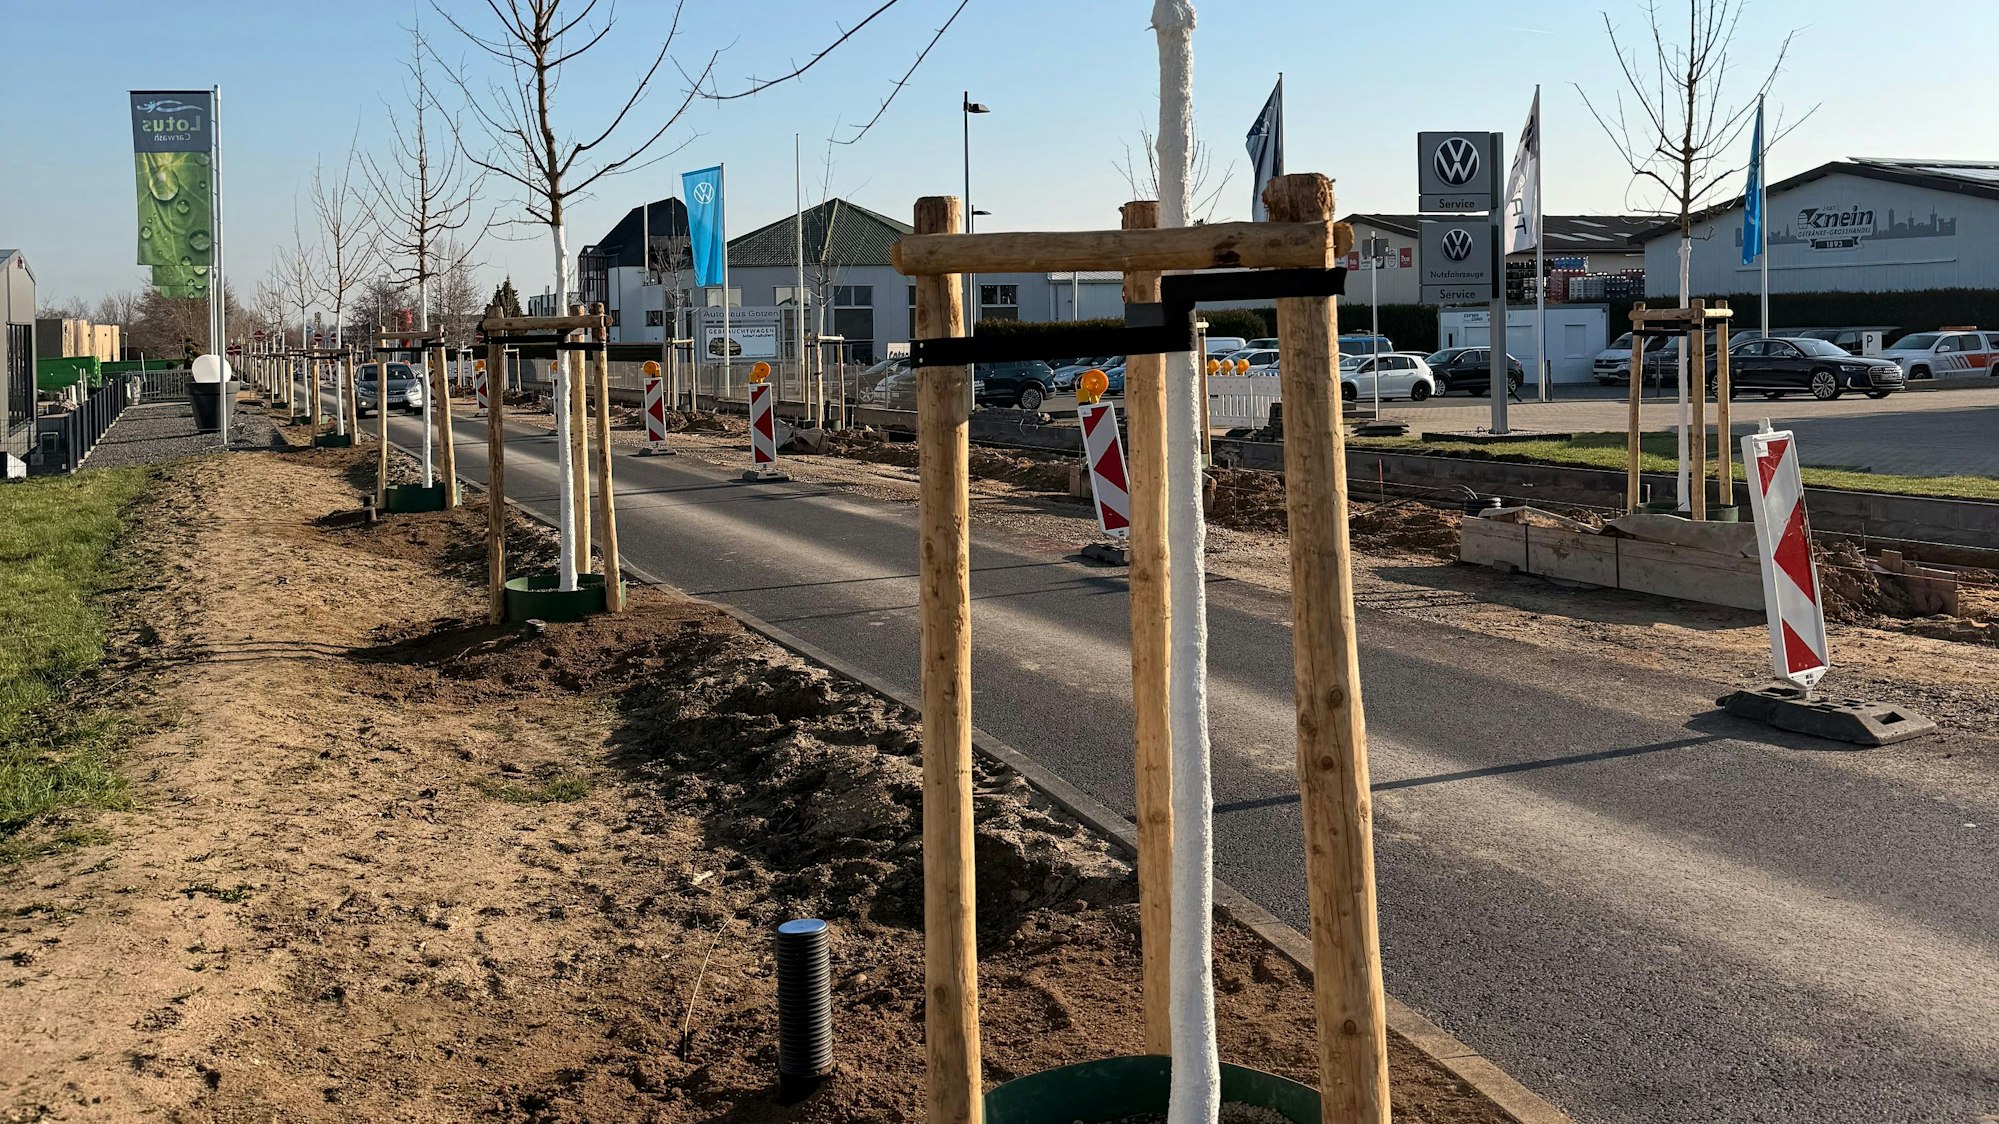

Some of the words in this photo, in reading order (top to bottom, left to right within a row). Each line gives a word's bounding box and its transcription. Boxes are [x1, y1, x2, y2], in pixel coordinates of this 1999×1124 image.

[1439, 198, 1475, 209] Service
[1799, 205, 1874, 229] Knein
[1826, 240, 1843, 248] 1893
[1440, 289, 1476, 299] Service
[703, 310, 746, 318] Autoaus
[1866, 335, 1874, 348] P
